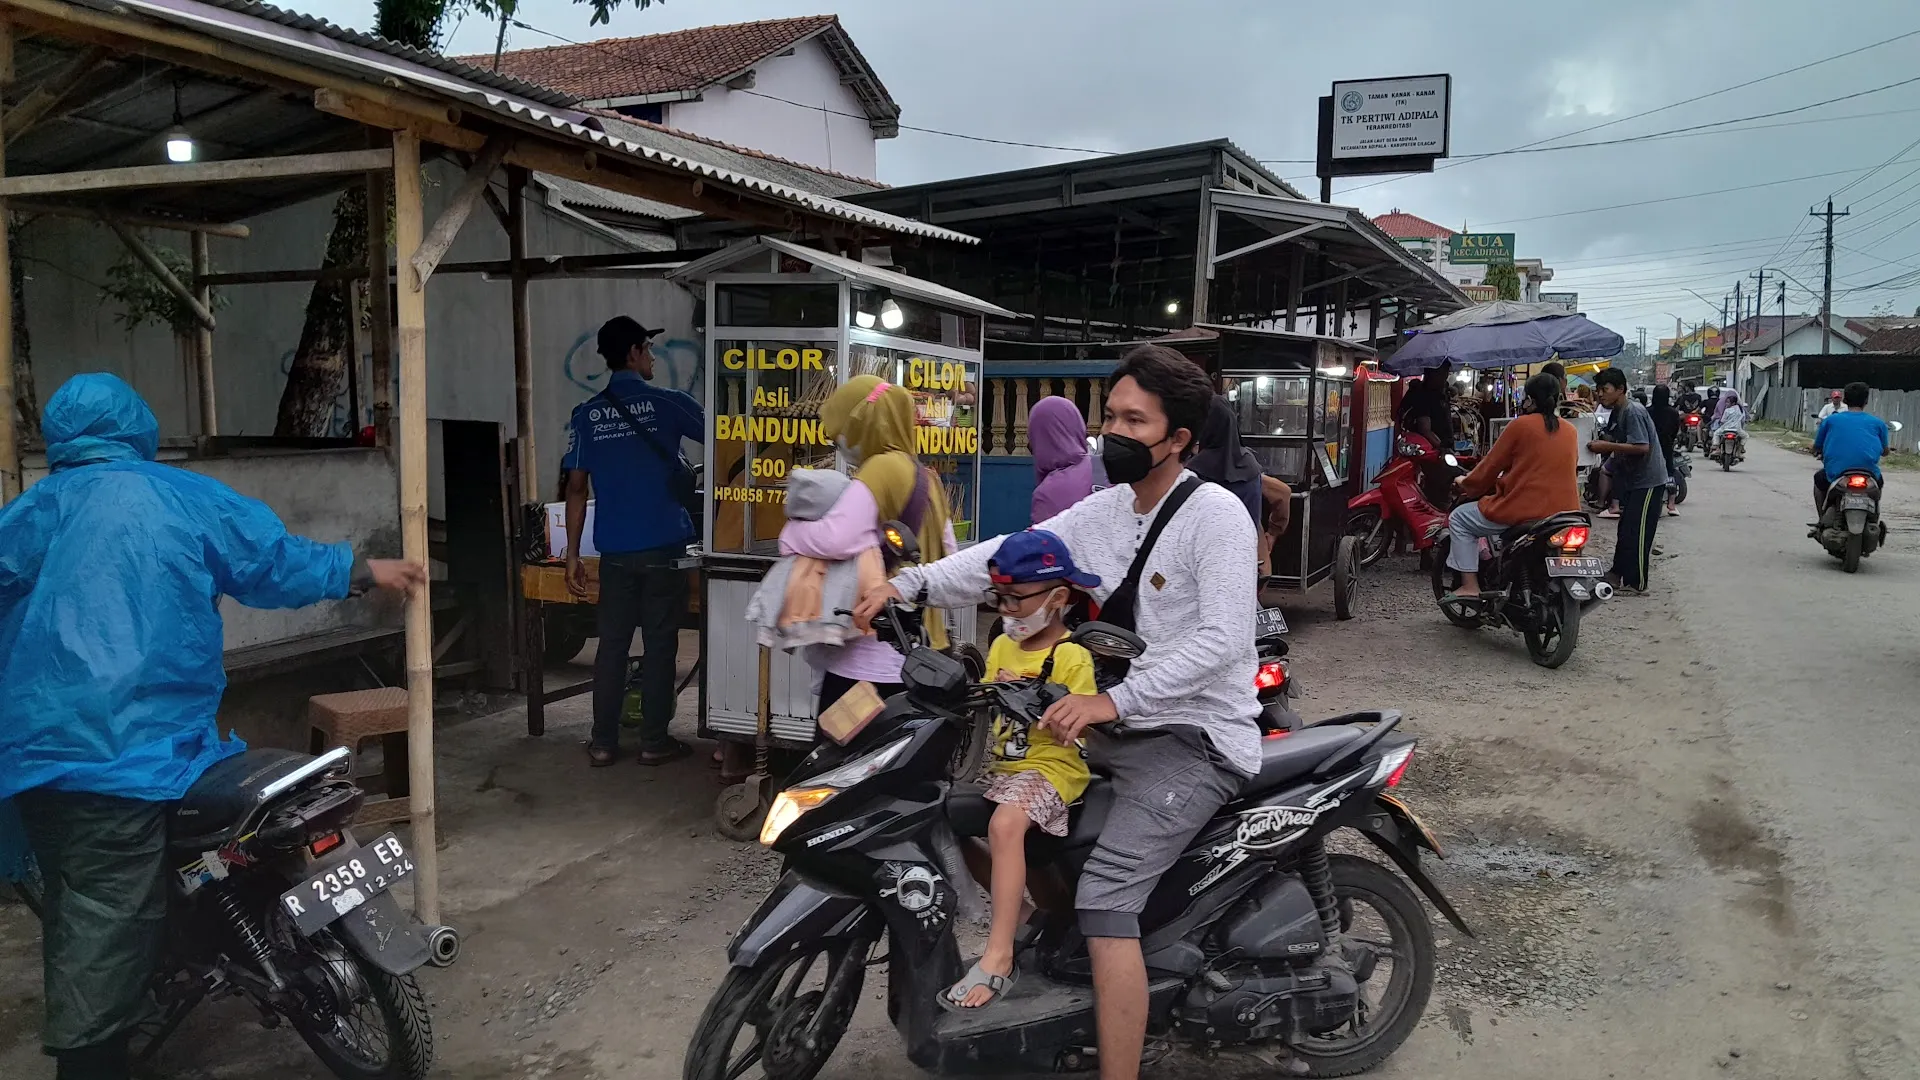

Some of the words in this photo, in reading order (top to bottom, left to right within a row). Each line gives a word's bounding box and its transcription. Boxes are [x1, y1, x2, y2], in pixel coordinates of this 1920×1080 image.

[1391, 91, 1411, 99] KANAK
[1415, 89, 1436, 97] KANAK
[1395, 99, 1408, 107] (TK)
[1340, 115, 1354, 124] TK
[1356, 113, 1395, 123] PERTIWI
[1398, 110, 1439, 121] ADIPALA
[1366, 123, 1412, 131] TERAKREDITASI
[1461, 235, 1504, 248] KUA
[1453, 248, 1473, 257] KEC.
[1474, 248, 1510, 257] ADIPALA
[723, 348, 823, 371] CILOR
[909, 357, 966, 391] CILOR
[753, 386, 789, 408] Asli
[602, 400, 655, 419] YAAHA
[926, 396, 948, 419] Asli
[593, 432, 625, 442] SEMAKIN
[916, 426, 978, 455] NDUNG
[751, 458, 786, 478] 500
[714, 486, 763, 504] HP.0858
[767, 489, 788, 505] 772
[1549, 559, 1556, 567] R
[1561, 559, 1582, 567] 4249
[806, 825, 856, 848] HONDA
[284, 895, 306, 917] R
[312, 858, 366, 902] 2358
[373, 837, 404, 865] EB
